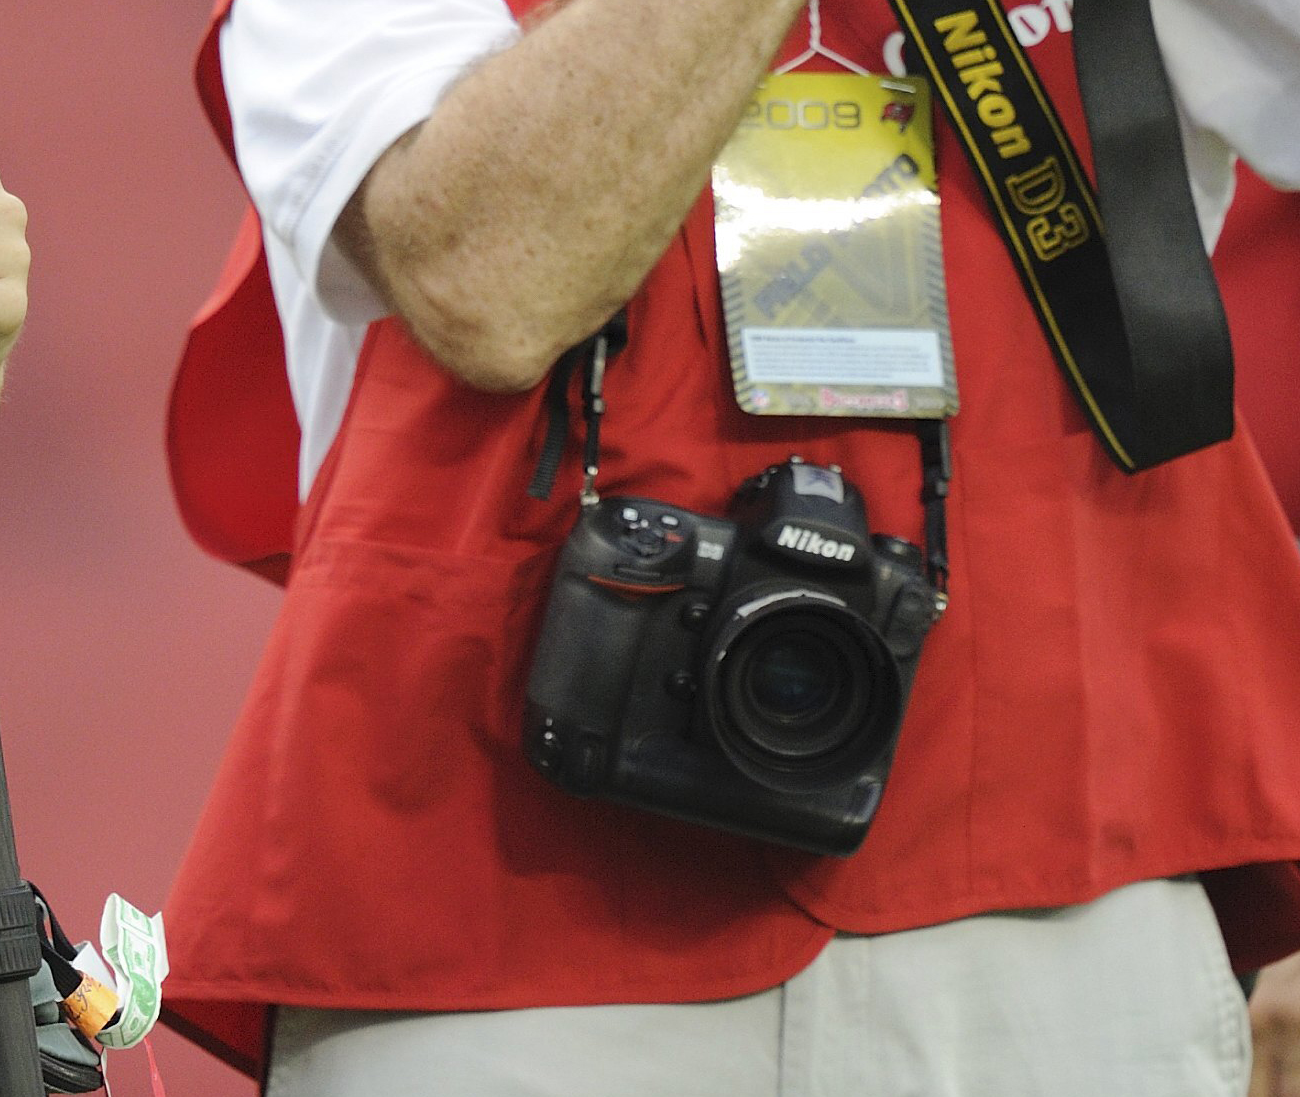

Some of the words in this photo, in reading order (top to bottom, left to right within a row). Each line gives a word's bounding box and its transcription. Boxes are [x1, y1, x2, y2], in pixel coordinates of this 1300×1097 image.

[934, 10, 1031, 160] Nikon
[1006, 155, 1088, 263] D3
[777, 525, 855, 562] Nikon
